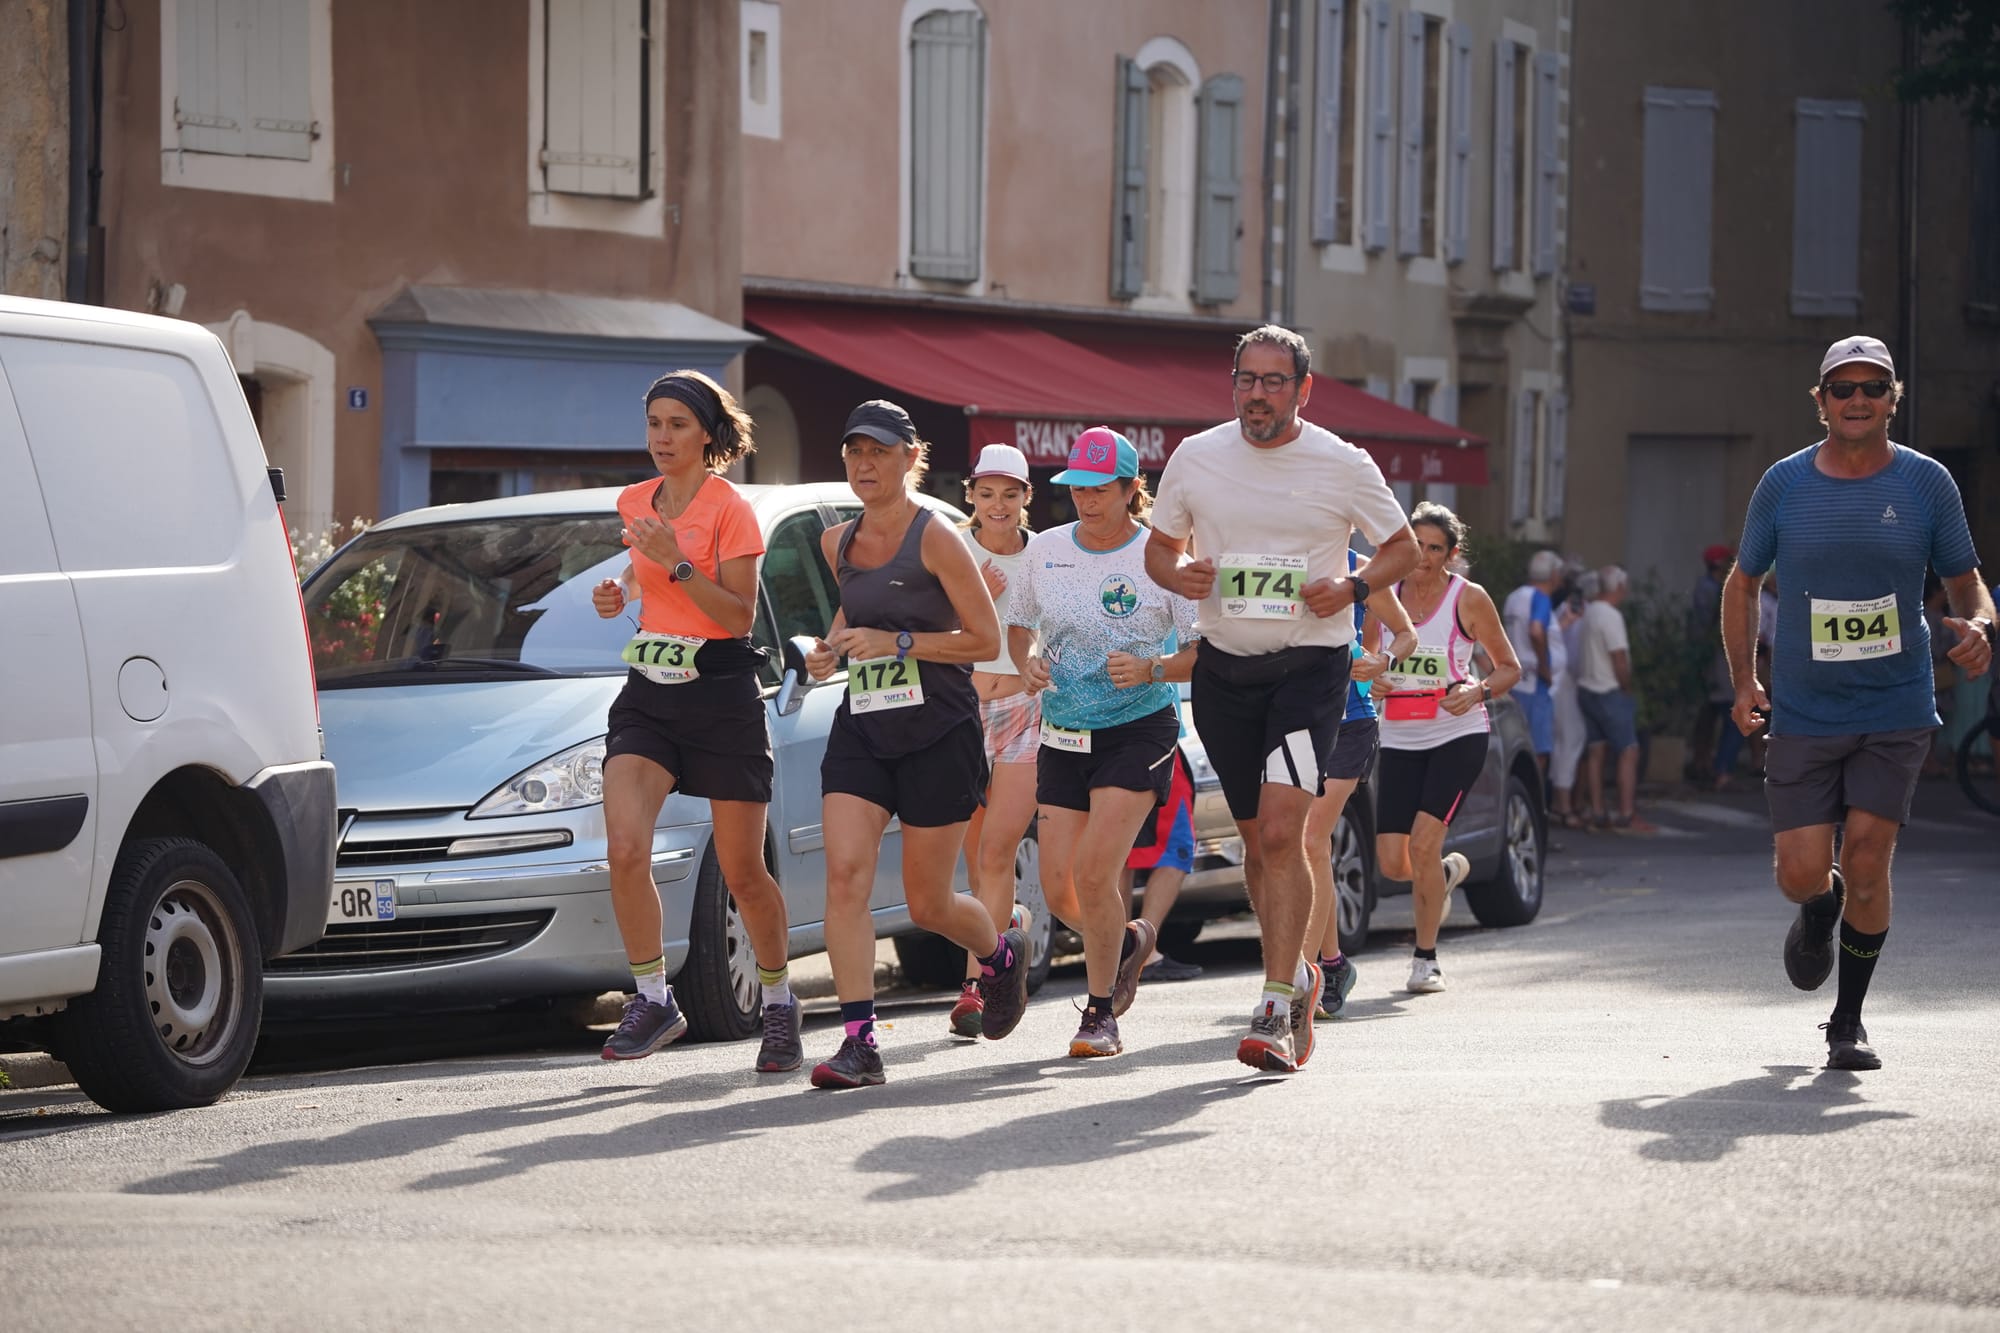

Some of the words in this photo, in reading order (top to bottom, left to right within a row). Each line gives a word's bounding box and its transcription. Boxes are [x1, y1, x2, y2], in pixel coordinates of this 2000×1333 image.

[354, 391, 363, 407] 6
[1125, 426, 1165, 461] BAR
[1232, 571, 1294, 598] 174
[1824, 614, 1888, 641] 194
[634, 641, 686, 666] 173
[857, 661, 908, 690] 172
[378, 901, 393, 914] 59
